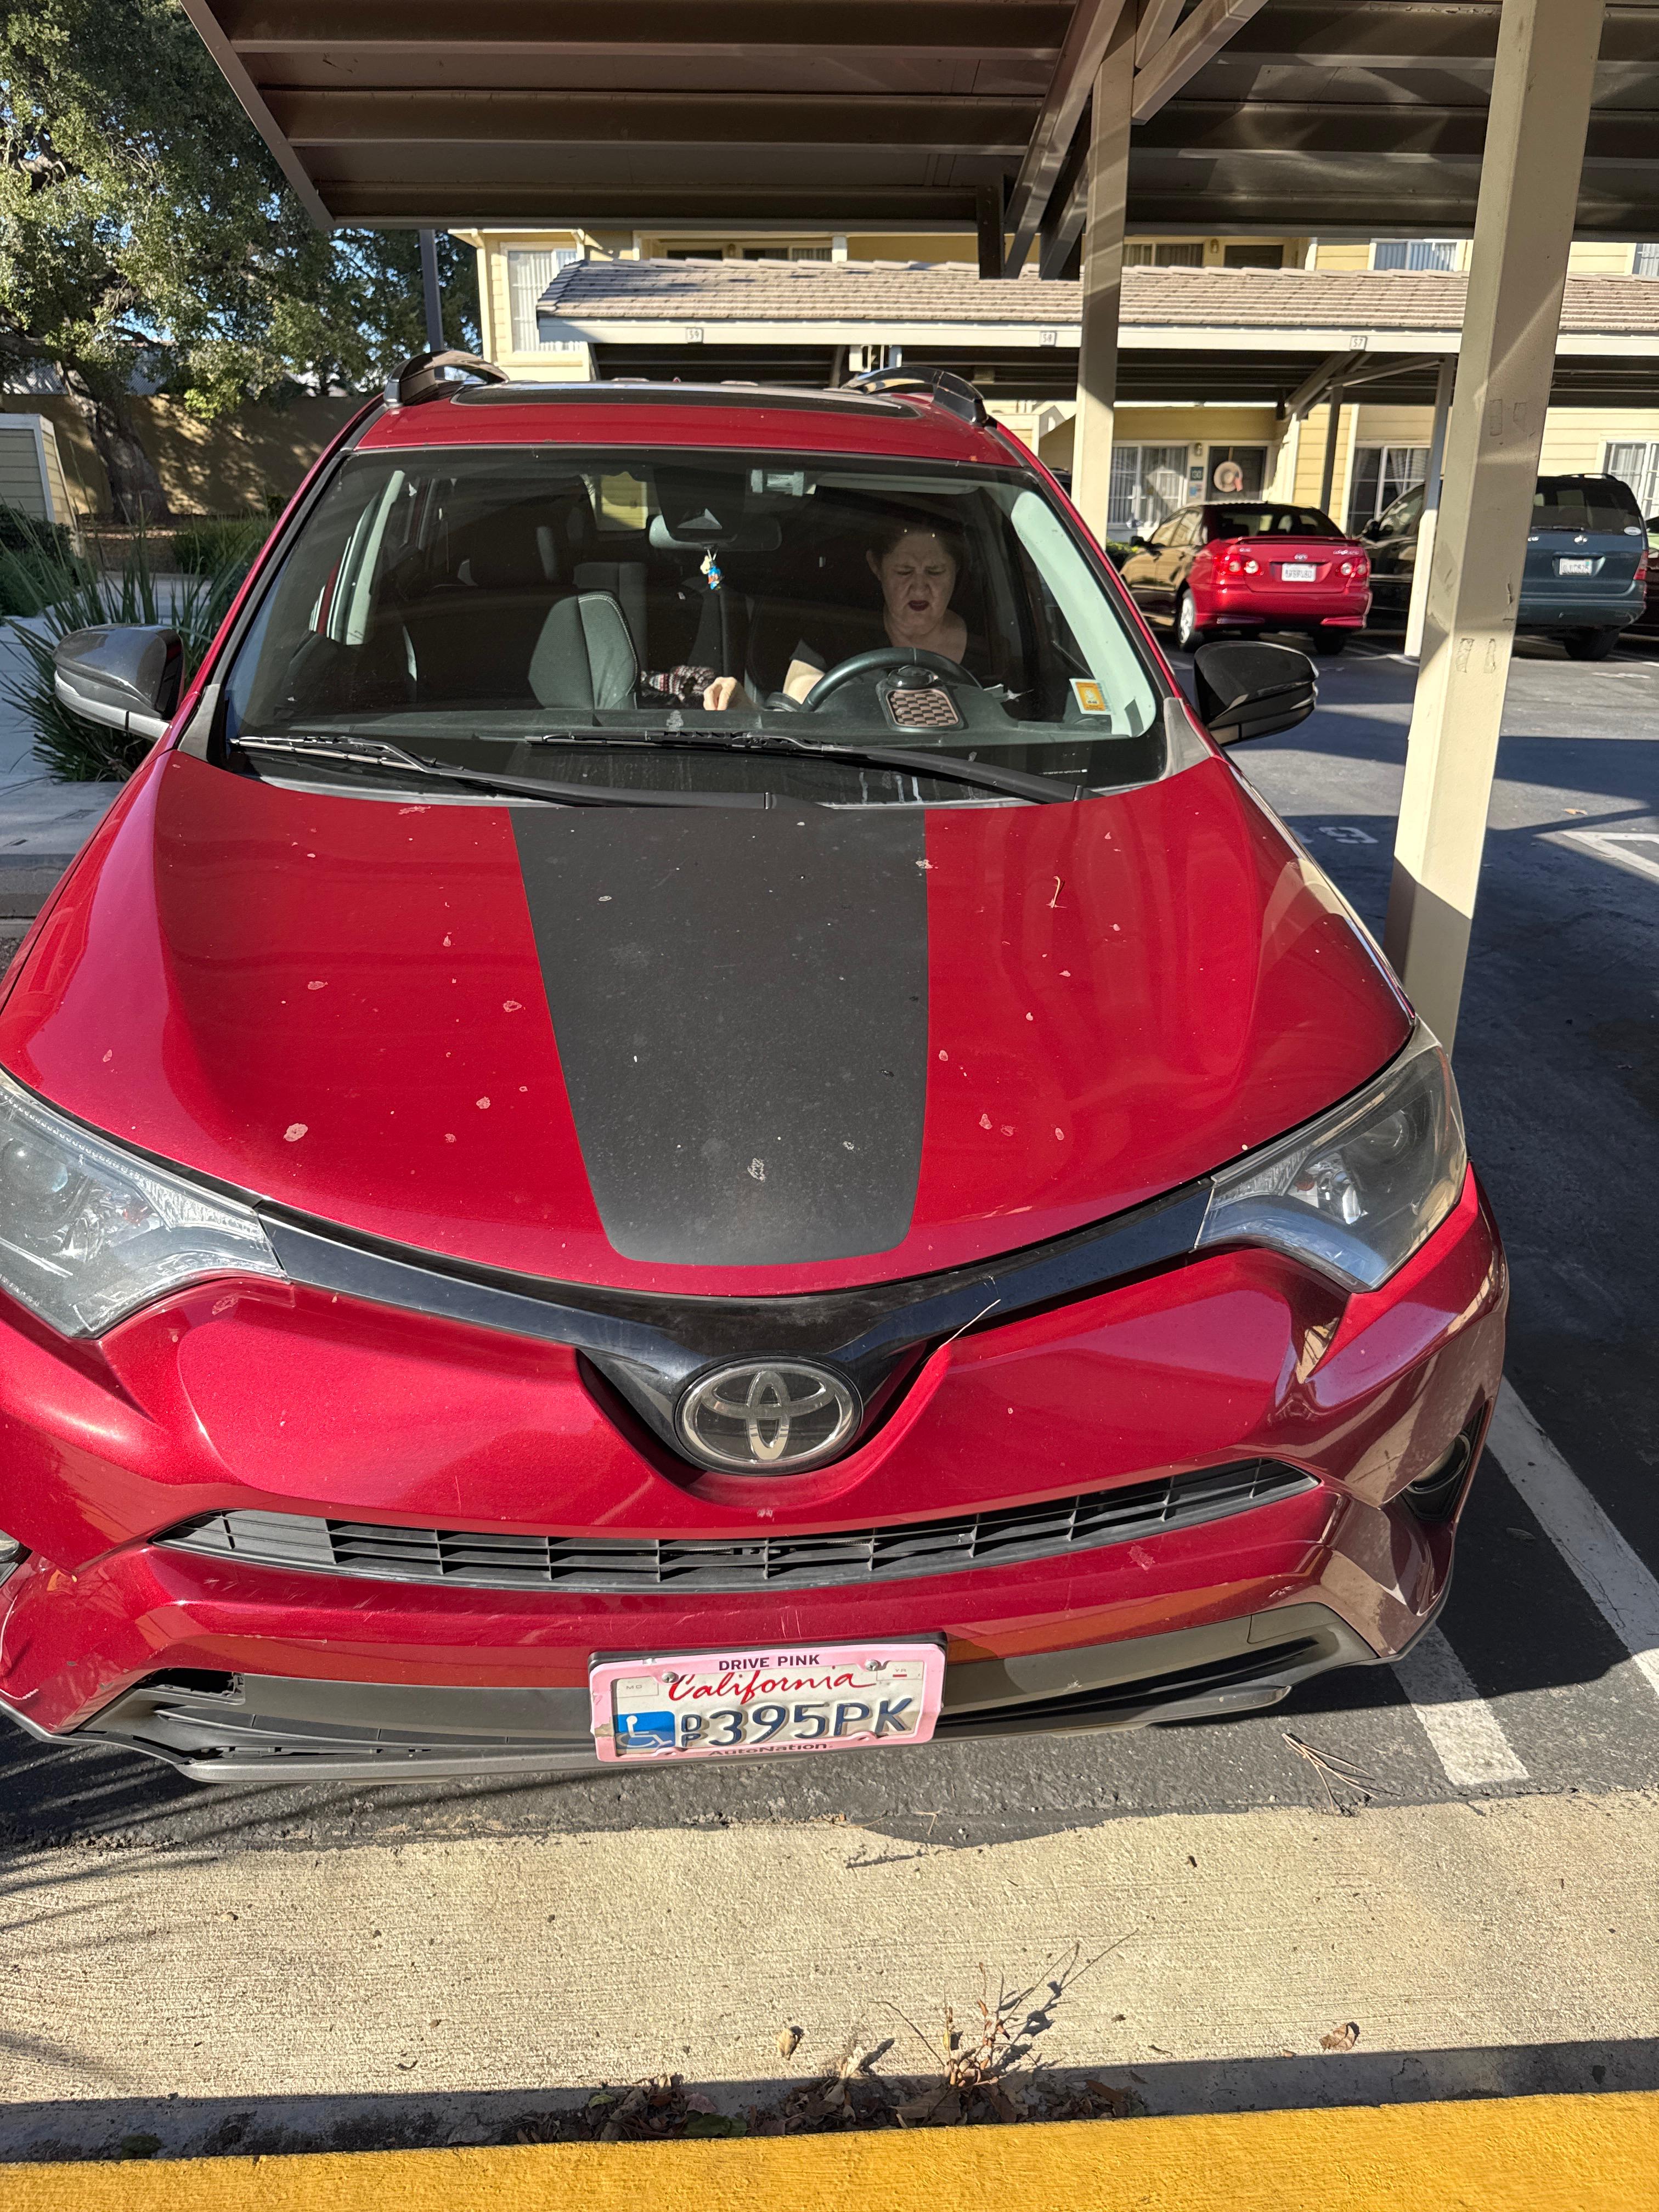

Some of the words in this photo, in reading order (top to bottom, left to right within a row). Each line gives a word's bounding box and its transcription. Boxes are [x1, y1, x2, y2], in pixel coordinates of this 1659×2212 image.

[1353, 338, 1363, 347] 57
[719, 1657, 769, 1671] DRIVE
[777, 1654, 820, 1667] PINK
[669, 1666, 877, 1705] California
[708, 1743, 827, 1756] AutoNation
